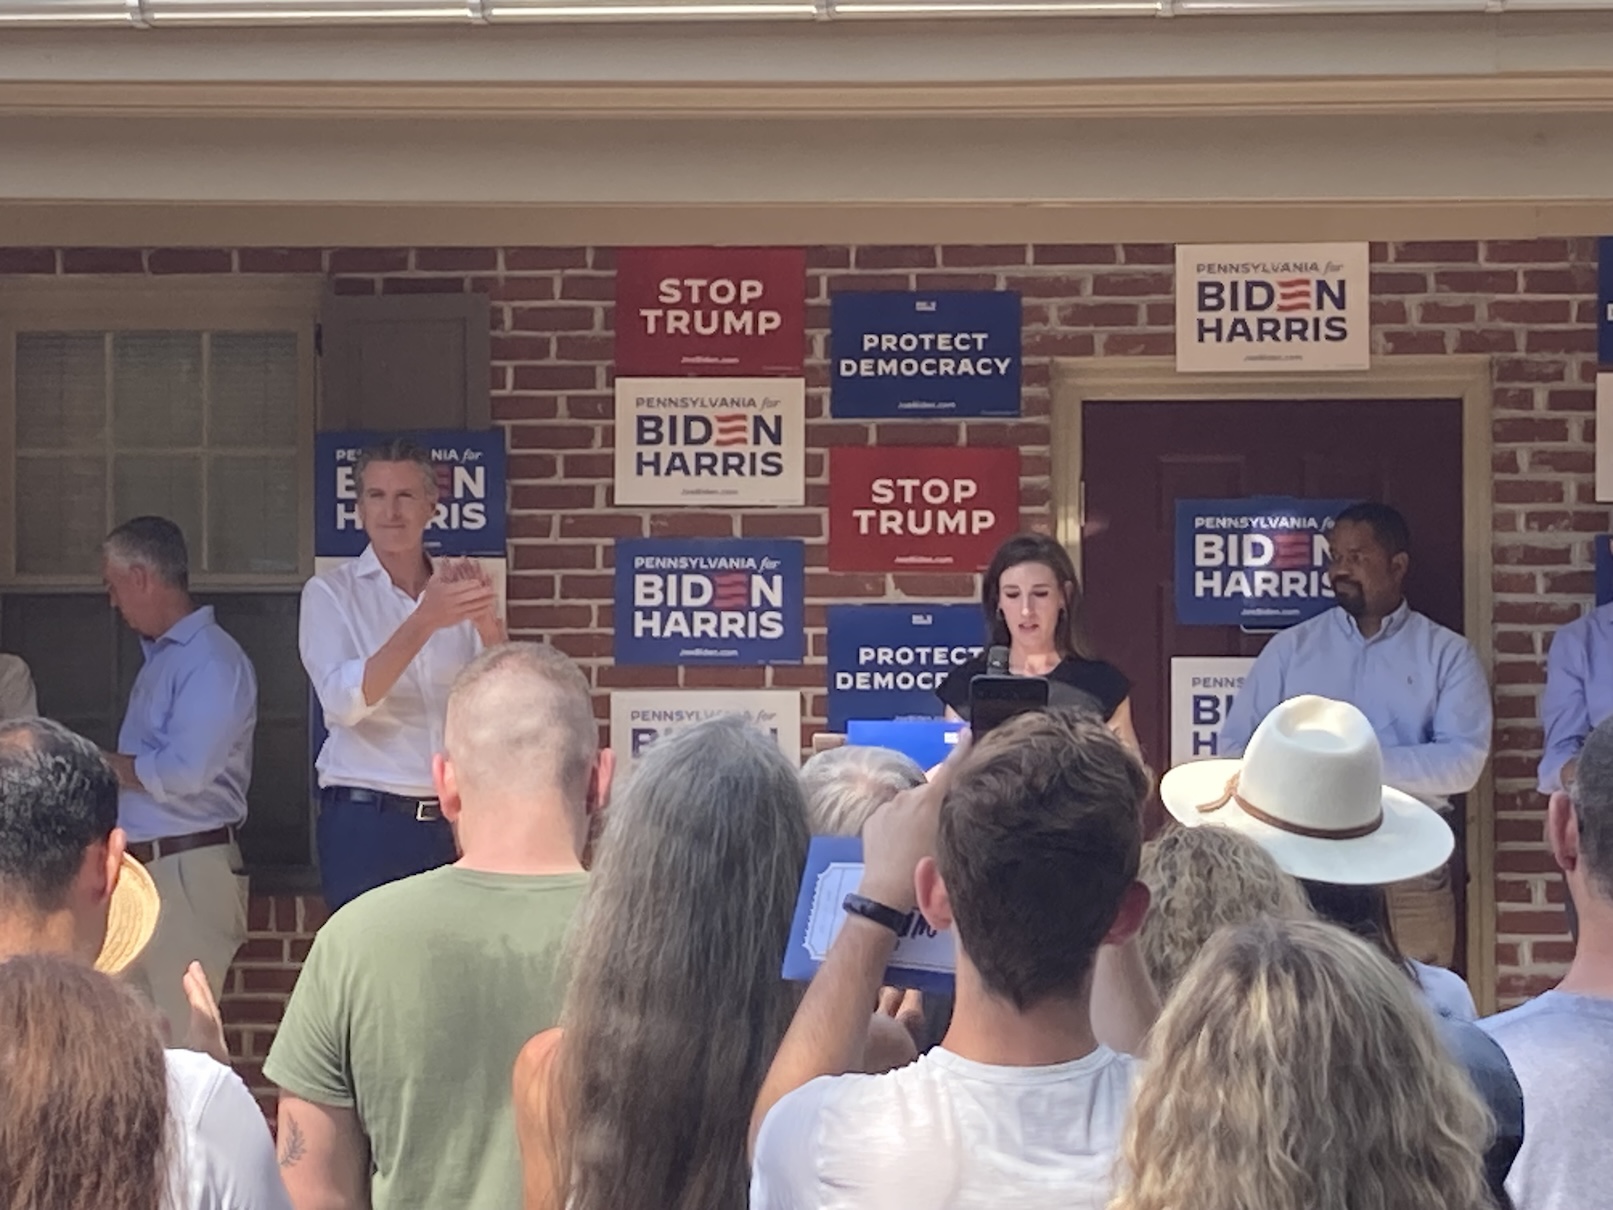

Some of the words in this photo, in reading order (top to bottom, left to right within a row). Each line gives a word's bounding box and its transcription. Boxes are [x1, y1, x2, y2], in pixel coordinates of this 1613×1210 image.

[1196, 262, 1320, 275] PENNSYLVANIA
[1323, 261, 1345, 276] for
[658, 277, 764, 305] STOP
[1197, 278, 1346, 312] BIDEN
[639, 309, 782, 336] TRUMP
[1197, 316, 1348, 343] HARRIS
[862, 333, 989, 352] PROTECT
[839, 358, 1012, 377] DEMOCRACY
[635, 397, 757, 409] PENNSYLVANIA
[760, 397, 781, 411] for
[635, 413, 783, 447] BIDEN
[461, 448, 483, 464] for
[635, 451, 783, 477] HARRIS
[871, 478, 978, 504] STOP
[336, 502, 487, 530] HRIS
[853, 509, 996, 535] TRUMP
[1194, 516, 1318, 529] PENNSYLVANIA
[1320, 516, 1336, 532] fo
[634, 556, 756, 569] PENNSYLVANIA
[757, 556, 781, 572] for
[633, 573, 783, 609] BIDEN
[633, 611, 784, 639] HARRIS
[755, 709, 777, 724] for
